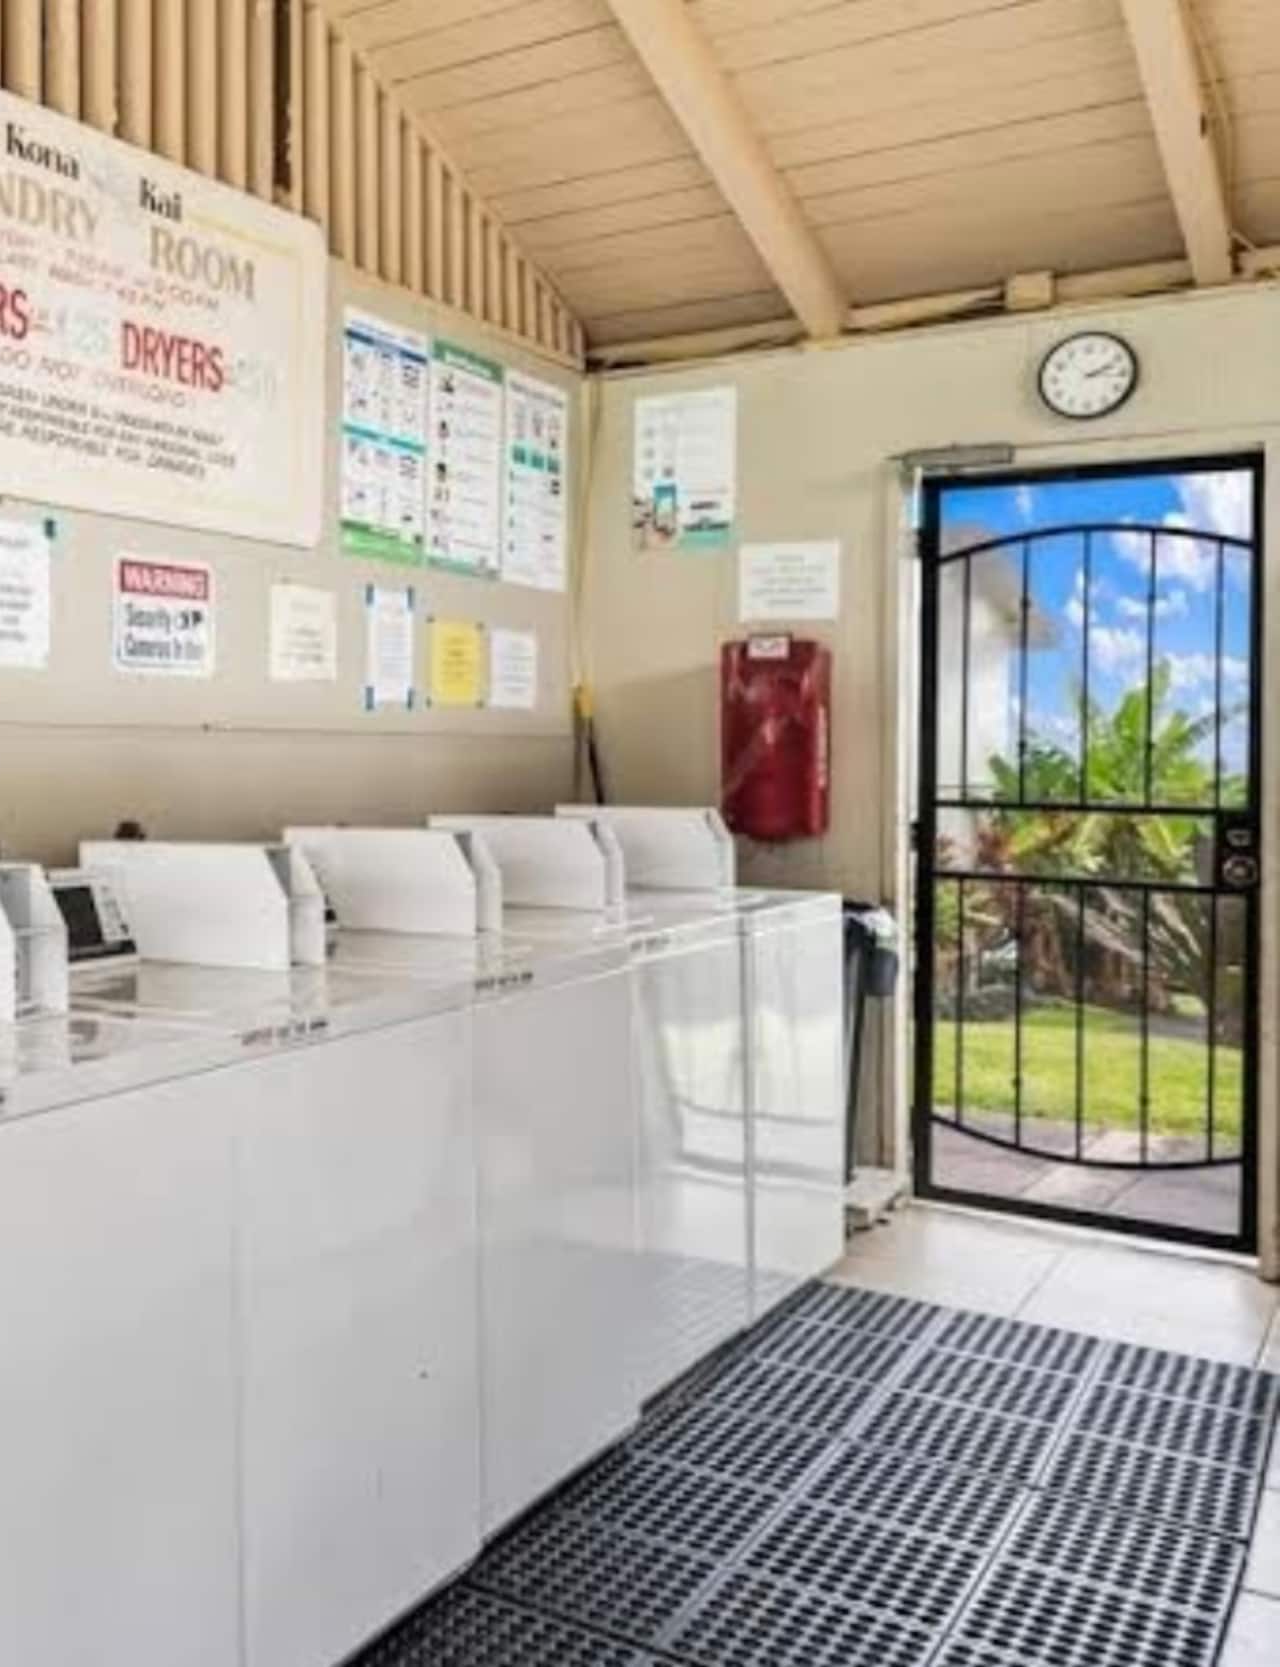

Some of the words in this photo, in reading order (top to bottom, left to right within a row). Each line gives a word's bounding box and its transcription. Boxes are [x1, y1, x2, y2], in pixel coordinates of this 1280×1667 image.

[5, 122, 81, 181] Kona
[140, 177, 182, 222] Kai
[149, 225, 256, 302] ROOM
[121, 320, 225, 393] DRYERS
[122, 563, 207, 598] WARNING
[125, 602, 171, 634] Security
[124, 636, 170, 660] Cameras
